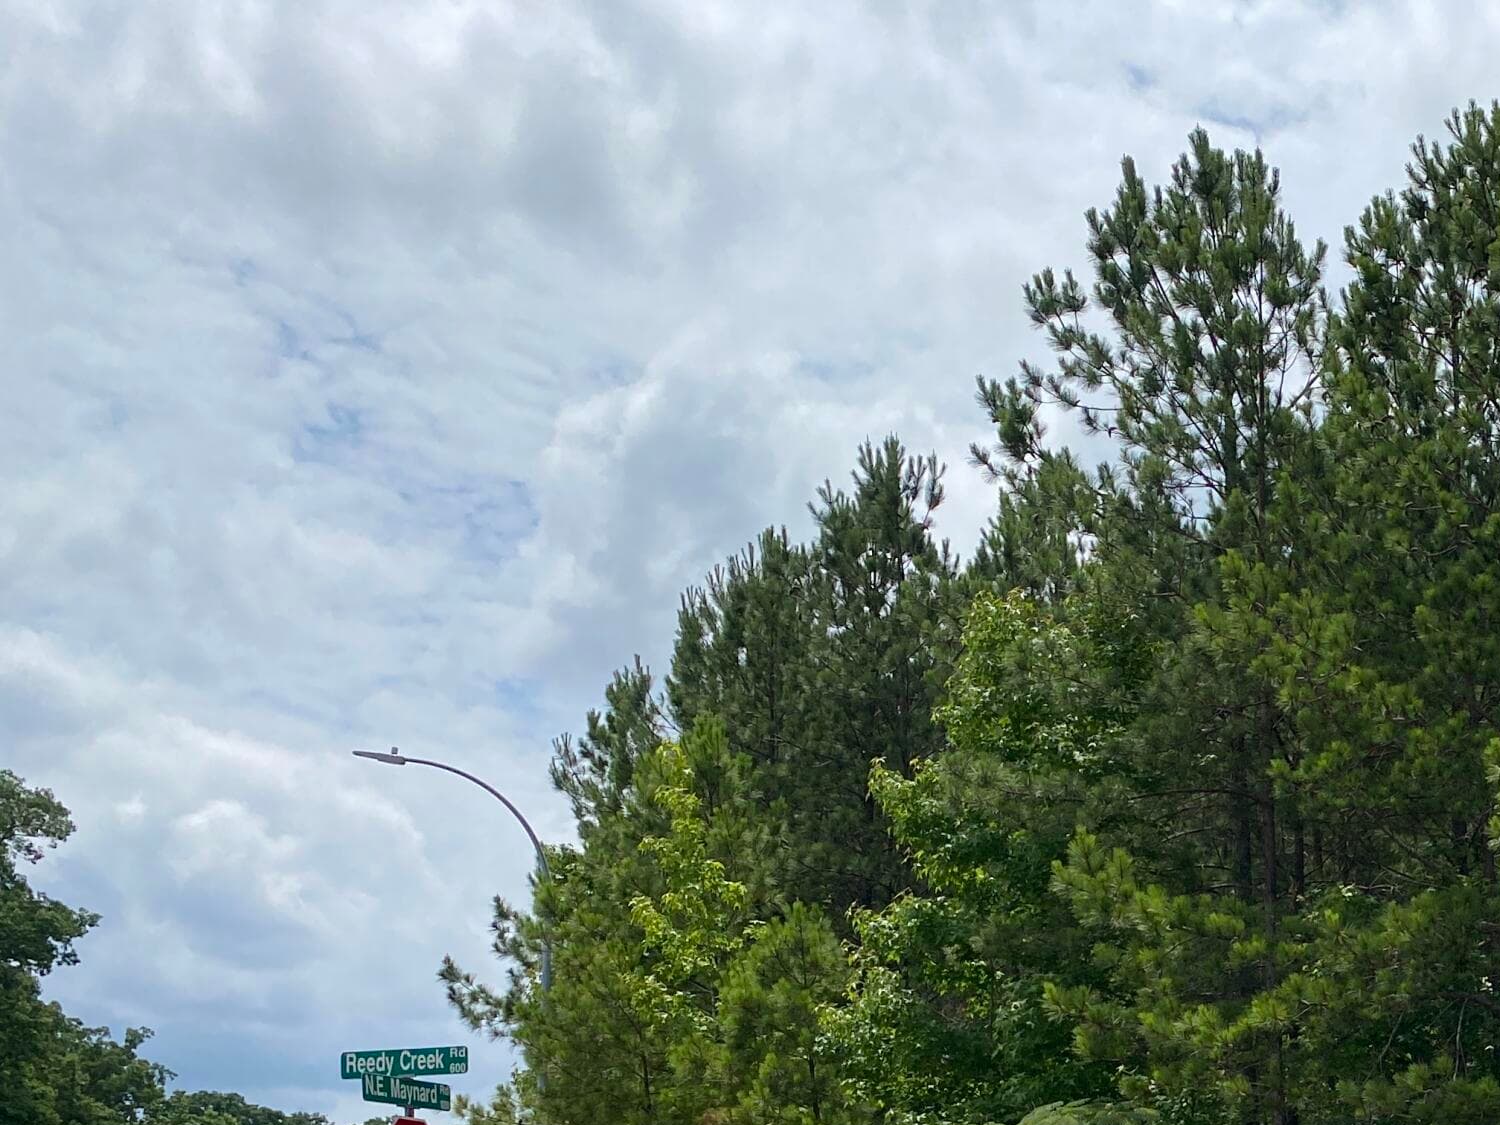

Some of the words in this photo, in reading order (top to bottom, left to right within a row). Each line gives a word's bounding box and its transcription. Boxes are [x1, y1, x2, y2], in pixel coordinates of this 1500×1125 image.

[346, 1052, 394, 1076] Reedy
[400, 1049, 445, 1071] Creek
[449, 1047, 466, 1058] Rd
[365, 1074, 388, 1098] N.E.
[391, 1078, 438, 1105] Maynard
